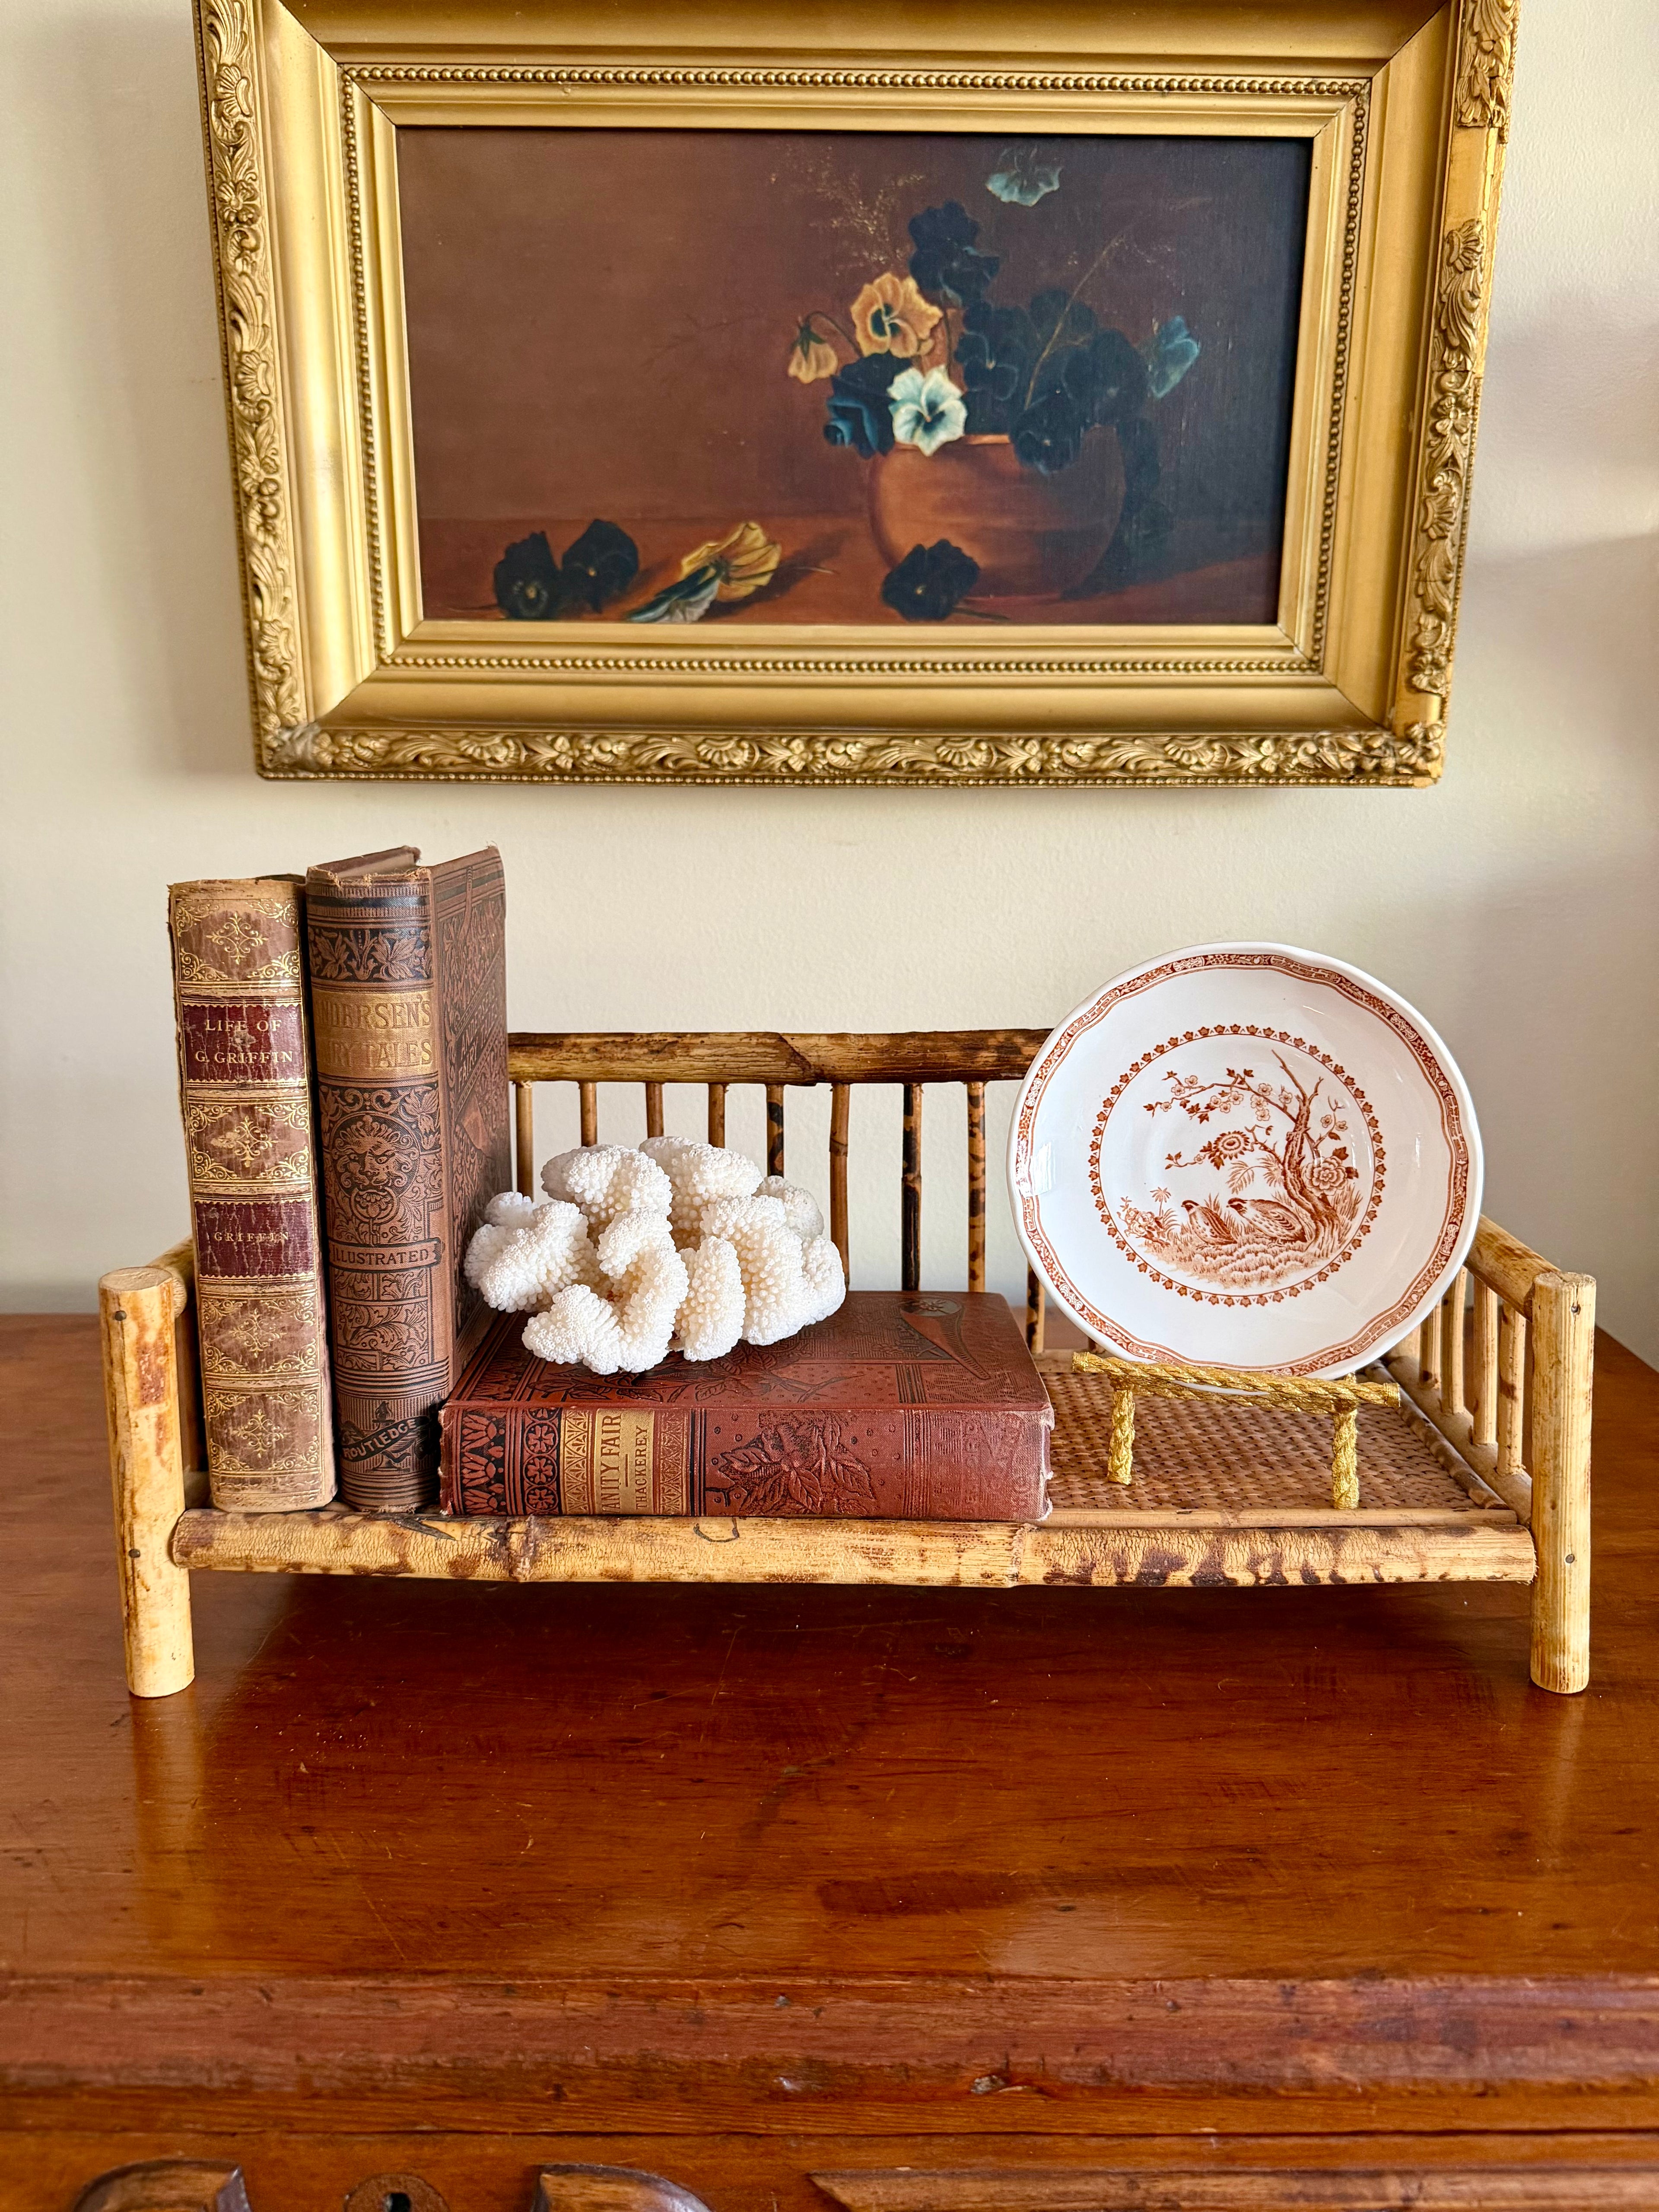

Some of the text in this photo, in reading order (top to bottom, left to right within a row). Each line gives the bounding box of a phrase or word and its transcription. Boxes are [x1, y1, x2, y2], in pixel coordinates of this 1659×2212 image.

[205, 1020, 282, 1032] LIFE OF
[195, 1051, 293, 1064] G. GRIFFIN
[362, 1039, 432, 1068] TALES
[459, 1037, 478, 1093] FAIRY
[214, 1232, 289, 1242] GRIFFIN
[332, 1244, 429, 1265] ILLUSTRATED
[343, 1419, 417, 1460] ROUTLEDGE
[601, 1414, 622, 1456] FAIR
[635, 1425, 648, 1510] THACKEREY
